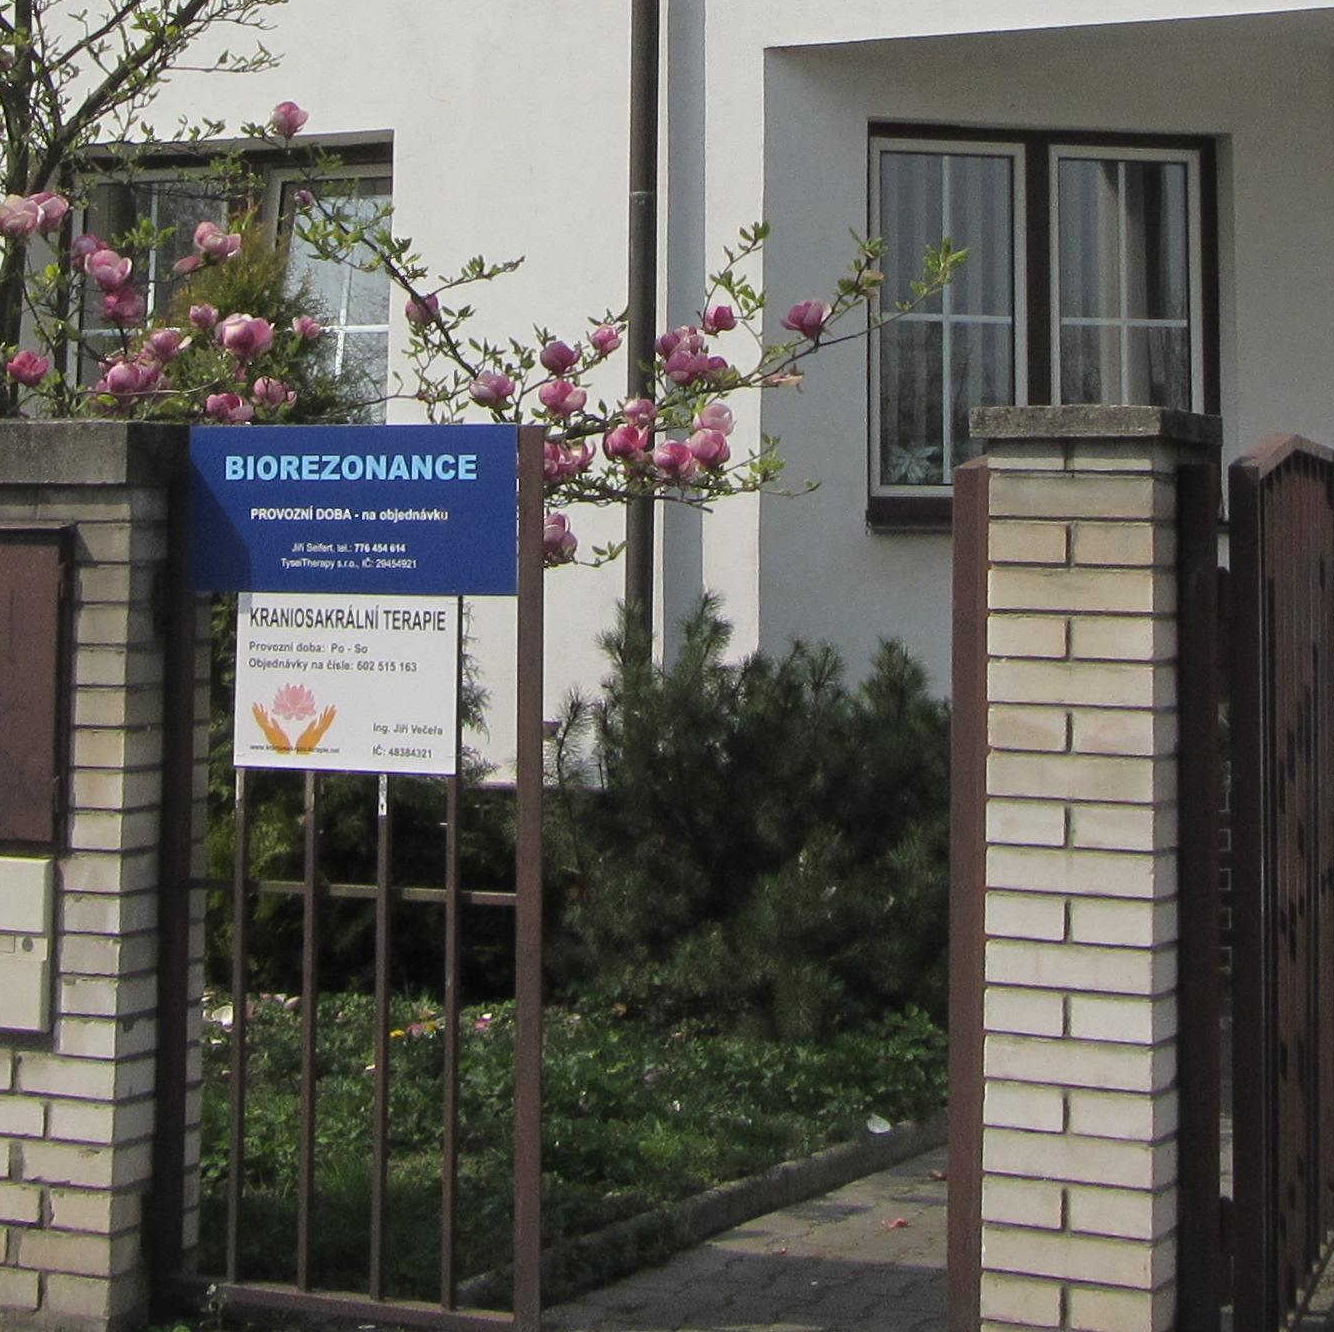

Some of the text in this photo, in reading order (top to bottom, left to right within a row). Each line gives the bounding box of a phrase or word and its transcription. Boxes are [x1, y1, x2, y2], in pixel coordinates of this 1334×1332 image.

[225, 454, 477, 481] BIOREZONANCE
[251, 506, 314, 521] PROVOZNÍ
[316, 509, 352, 521] DOBA
[362, 511, 376, 521] na
[379, 508, 448, 523] objednávku
[250, 604, 446, 631] KRANIOSAKRÁLNÍ TERAPIE
[248, 641, 293, 652] Provozní
[296, 642, 325, 653] doba:
[330, 643, 345, 654] Po
[354, 643, 368, 654] So
[248, 657, 307, 672] Objednávky
[311, 661, 324, 669] na
[357, 660, 375, 671] 602
[378, 661, 396, 671] 515
[400, 662, 417, 672] 163
